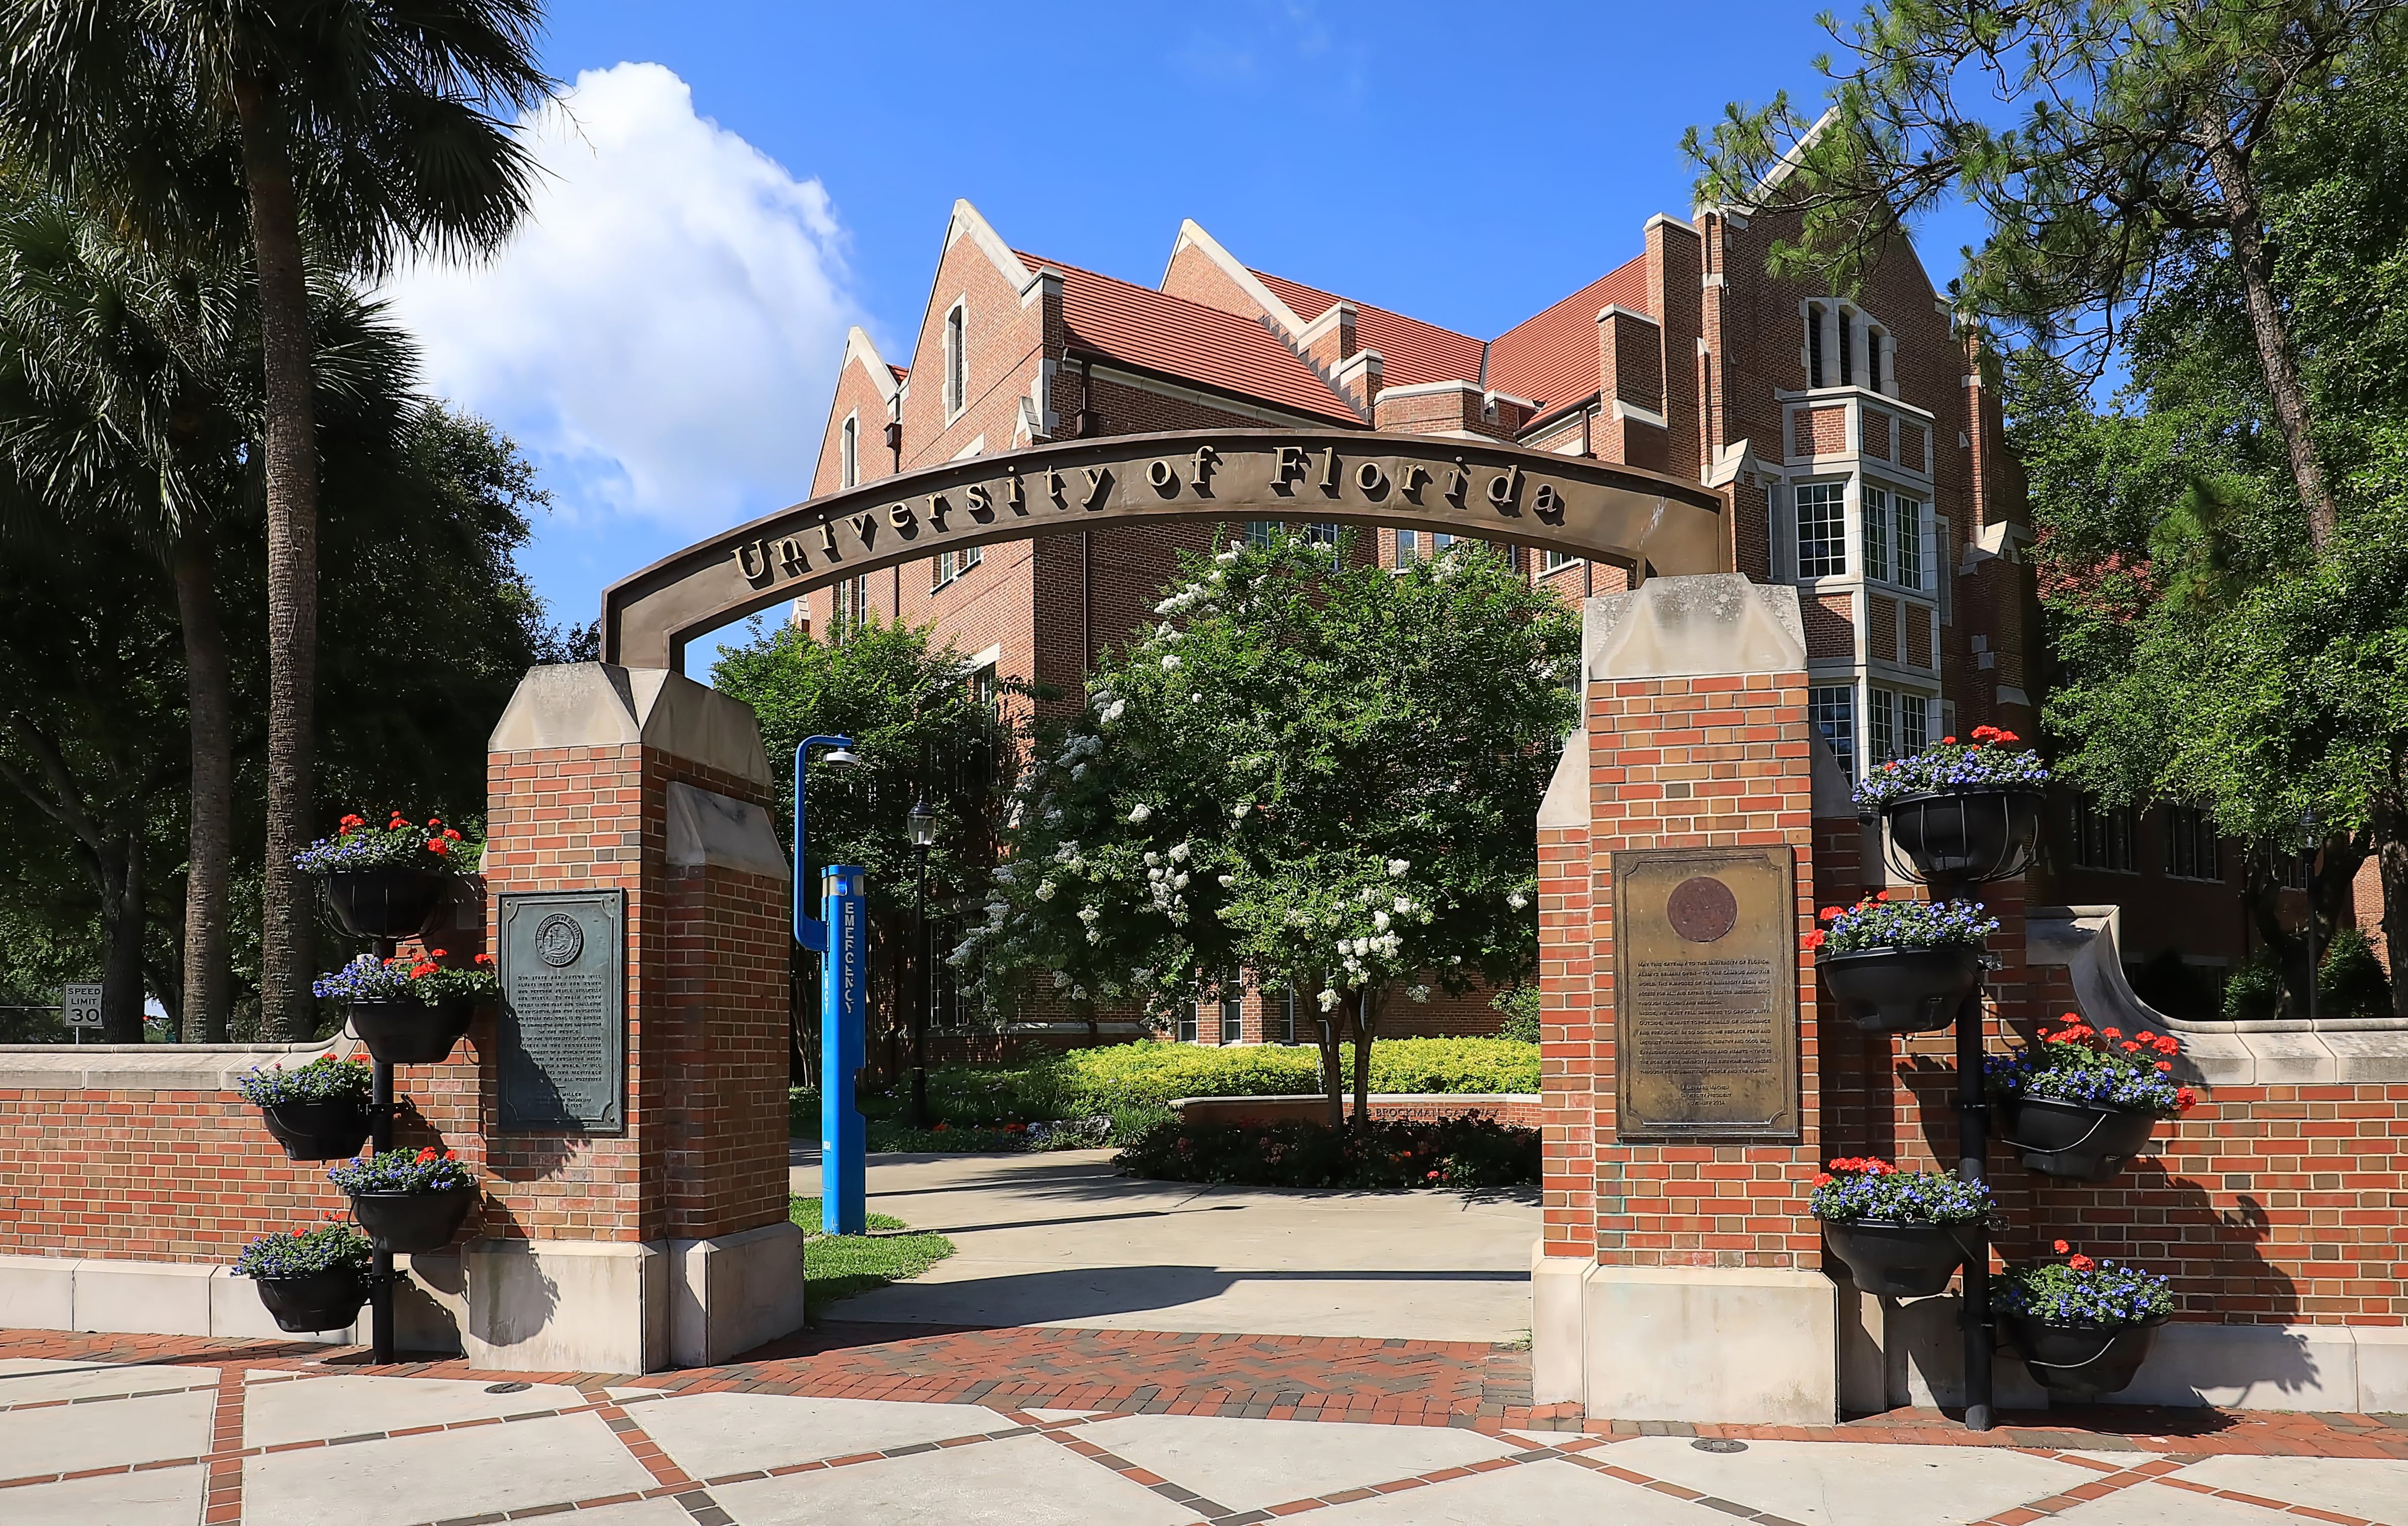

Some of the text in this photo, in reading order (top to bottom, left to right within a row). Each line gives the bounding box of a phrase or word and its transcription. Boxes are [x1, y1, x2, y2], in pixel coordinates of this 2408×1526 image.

[730, 445, 1557, 580] University of Florida
[845, 901, 855, 1014] EMERGENCY
[70, 1008, 99, 1022] 30
[1376, 1108, 1440, 1117] BROCKMAN
